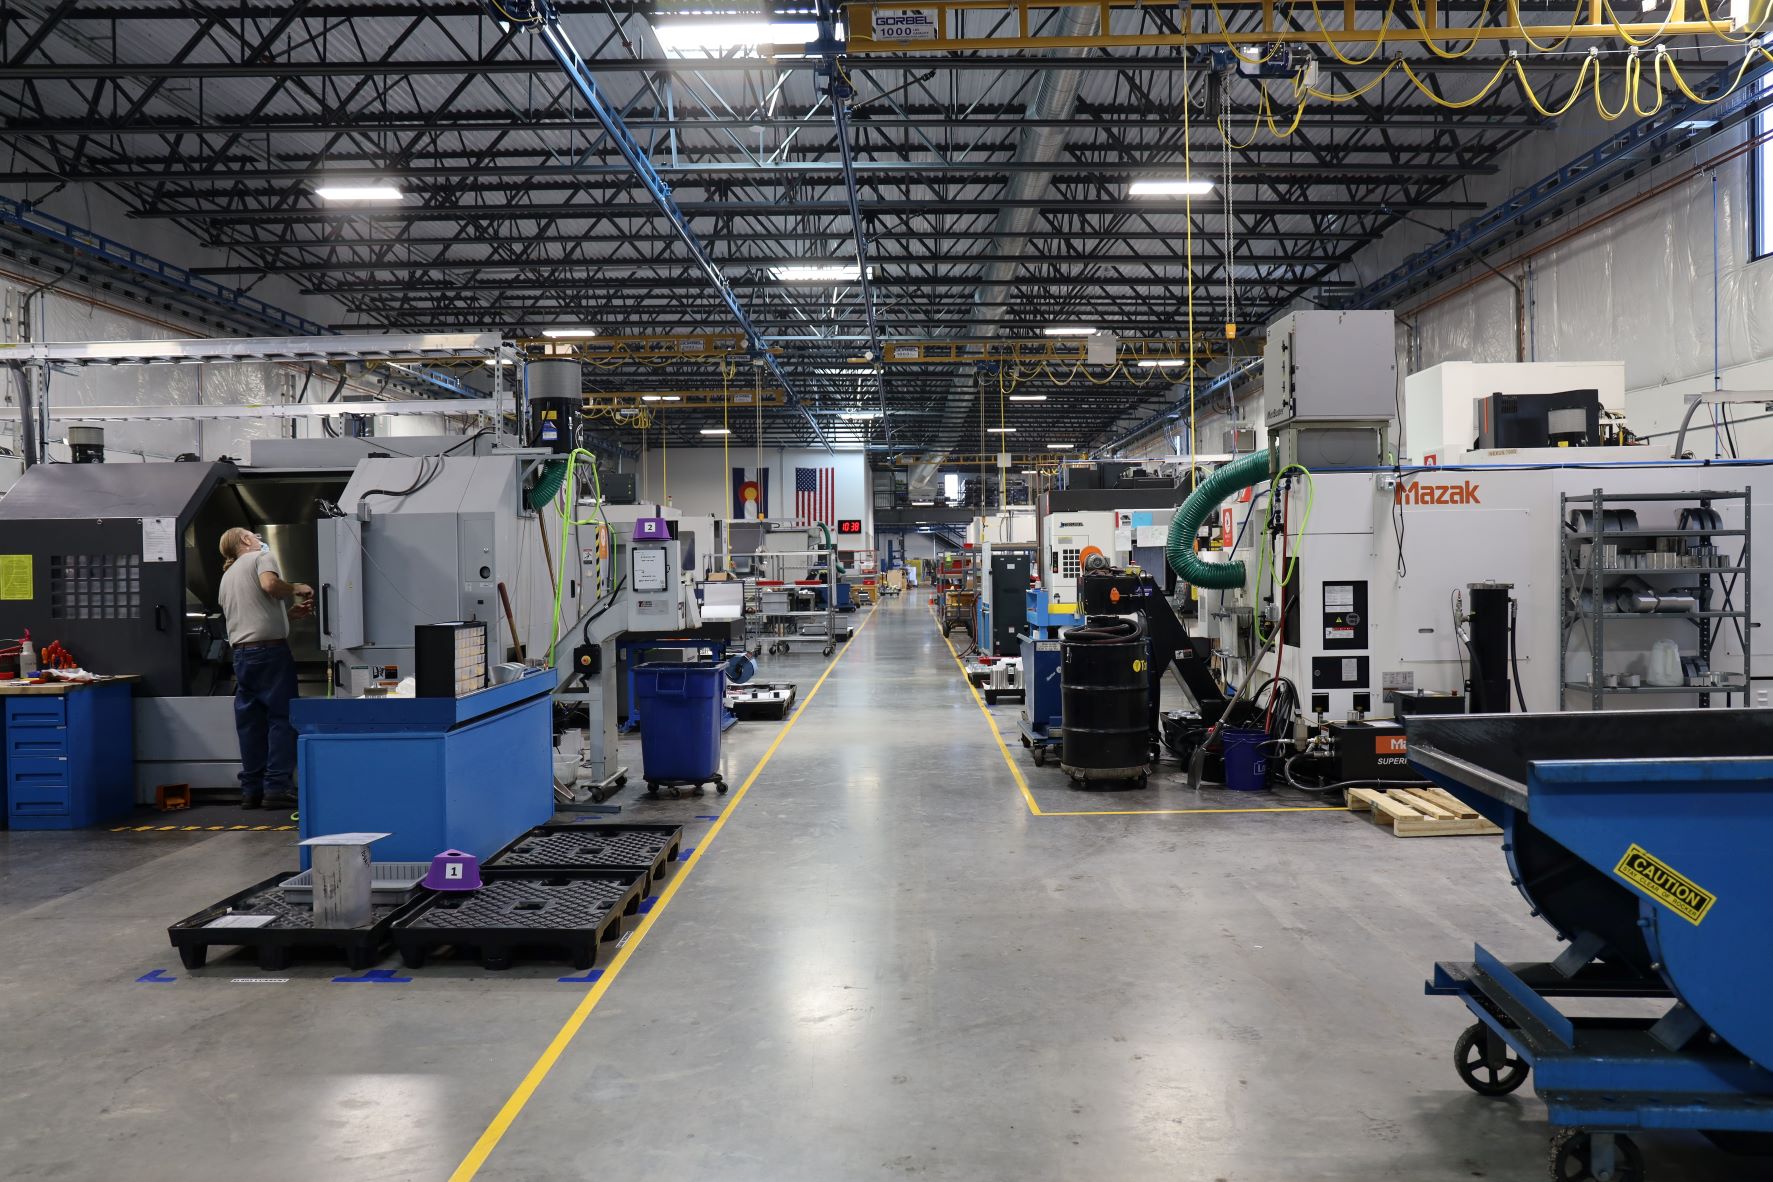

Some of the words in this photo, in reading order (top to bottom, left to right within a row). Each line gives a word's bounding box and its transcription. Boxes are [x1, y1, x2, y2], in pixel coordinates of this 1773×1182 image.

[876, 16, 934, 26] GORBEL
[880, 27, 912, 36] 1000
[1395, 480, 1481, 505] Mazak
[451, 867, 457, 876] 1
[1634, 858, 1701, 907] CAUTION
[1622, 866, 1638, 878] STAY
[1640, 877, 1660, 893] CLEAR
[1661, 891, 1671, 899] OF
[1672, 897, 1697, 917] ROCKER
